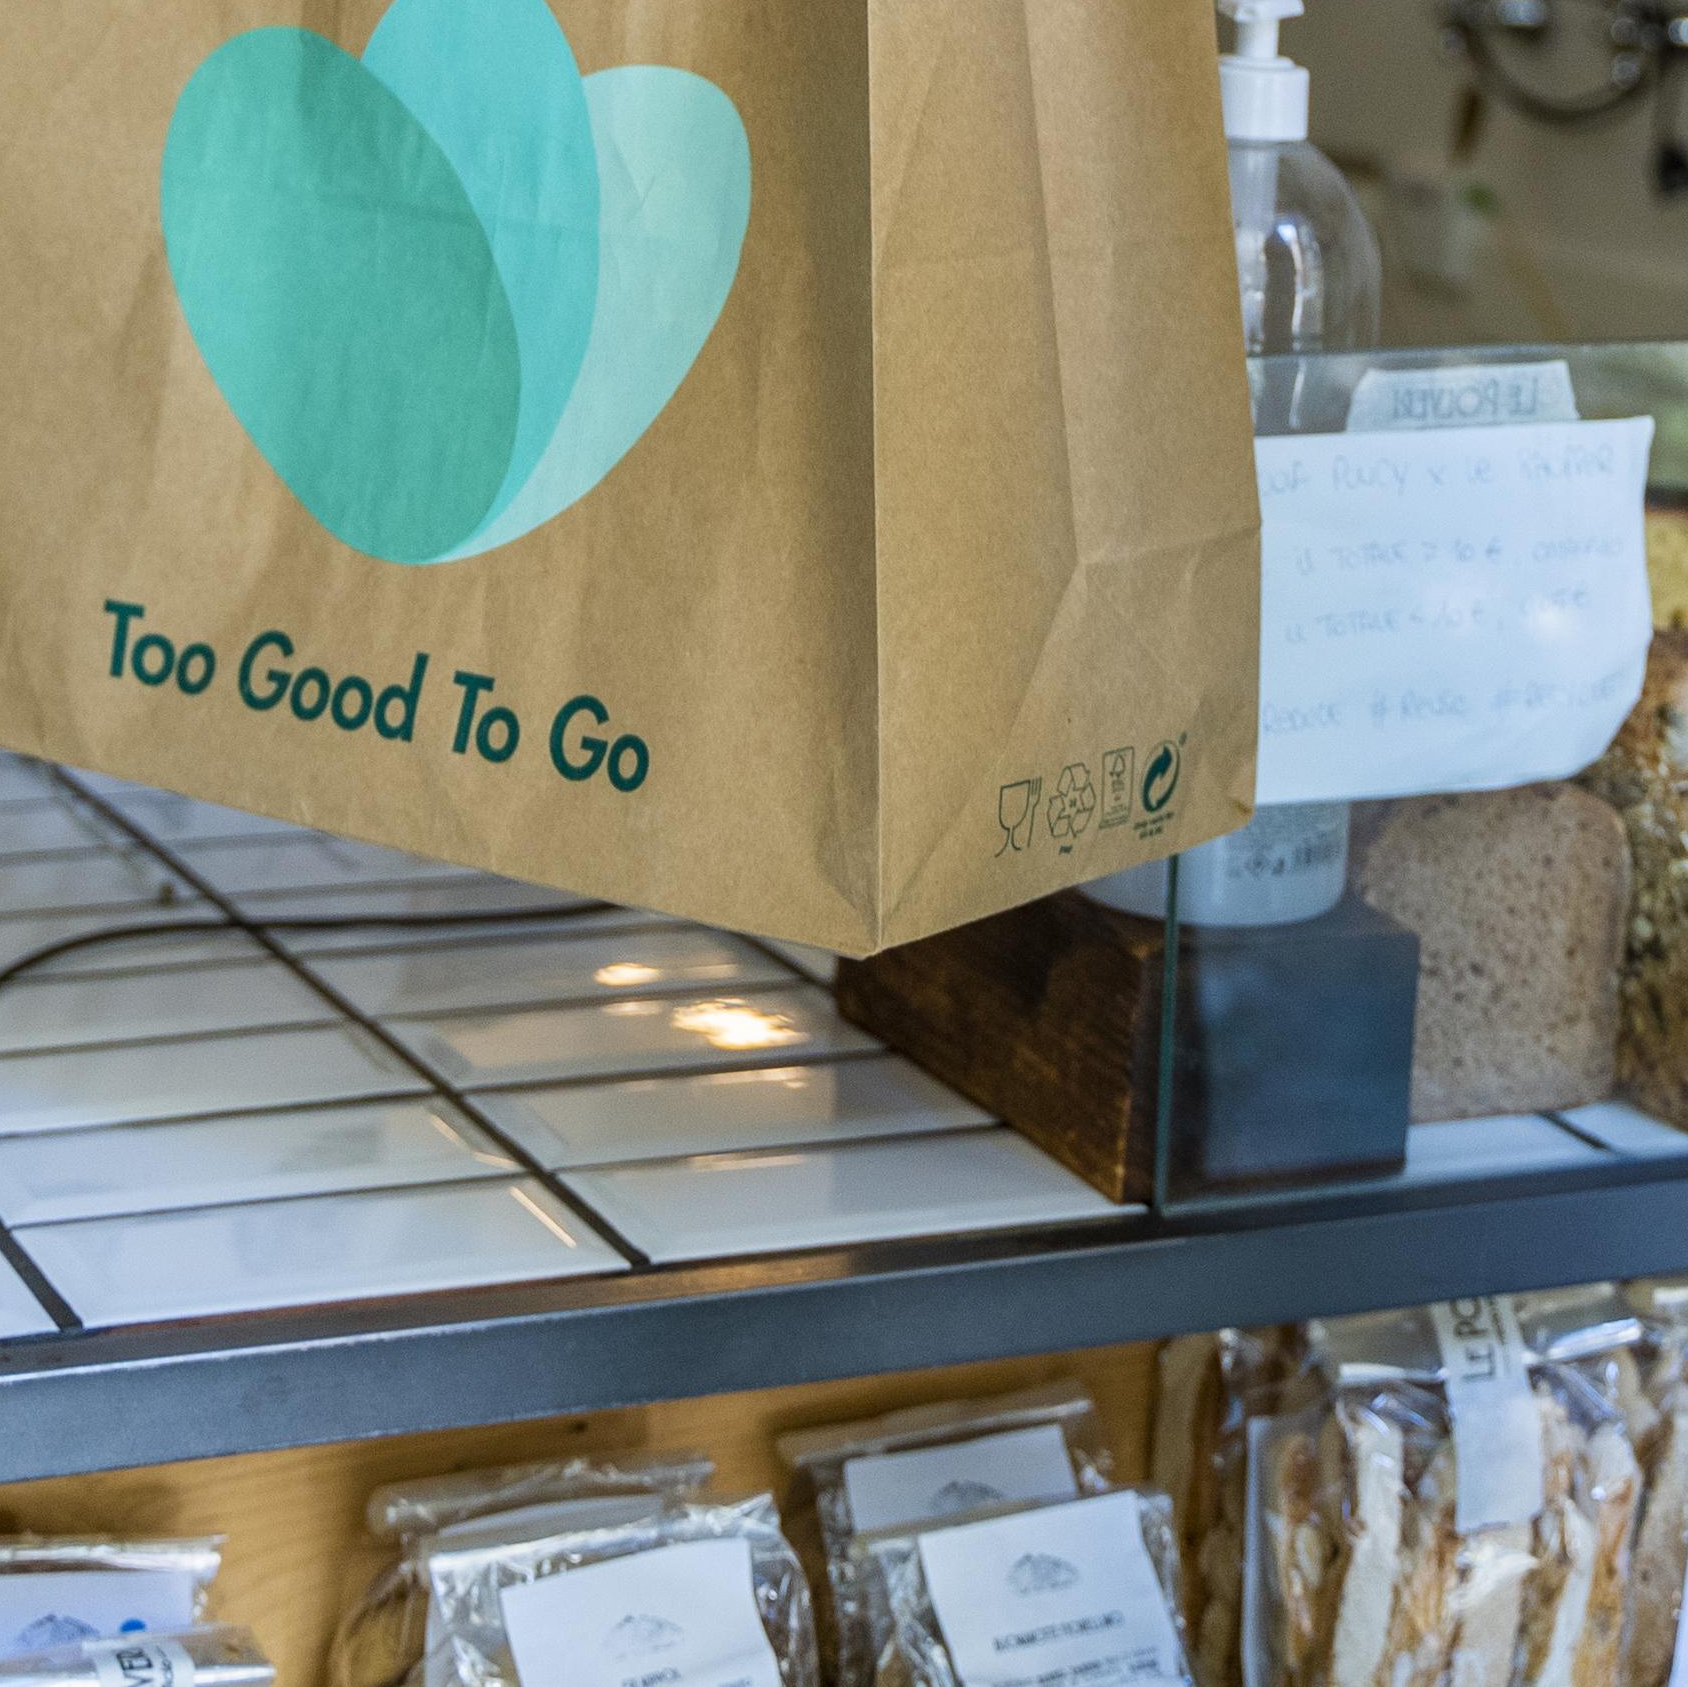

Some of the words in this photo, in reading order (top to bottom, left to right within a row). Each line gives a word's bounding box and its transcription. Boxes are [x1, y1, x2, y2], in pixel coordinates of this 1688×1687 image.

[104, 599, 216, 696] Too
[237, 629, 430, 743] Good
[451, 670, 521, 764] To
[548, 694, 651, 794] Go
